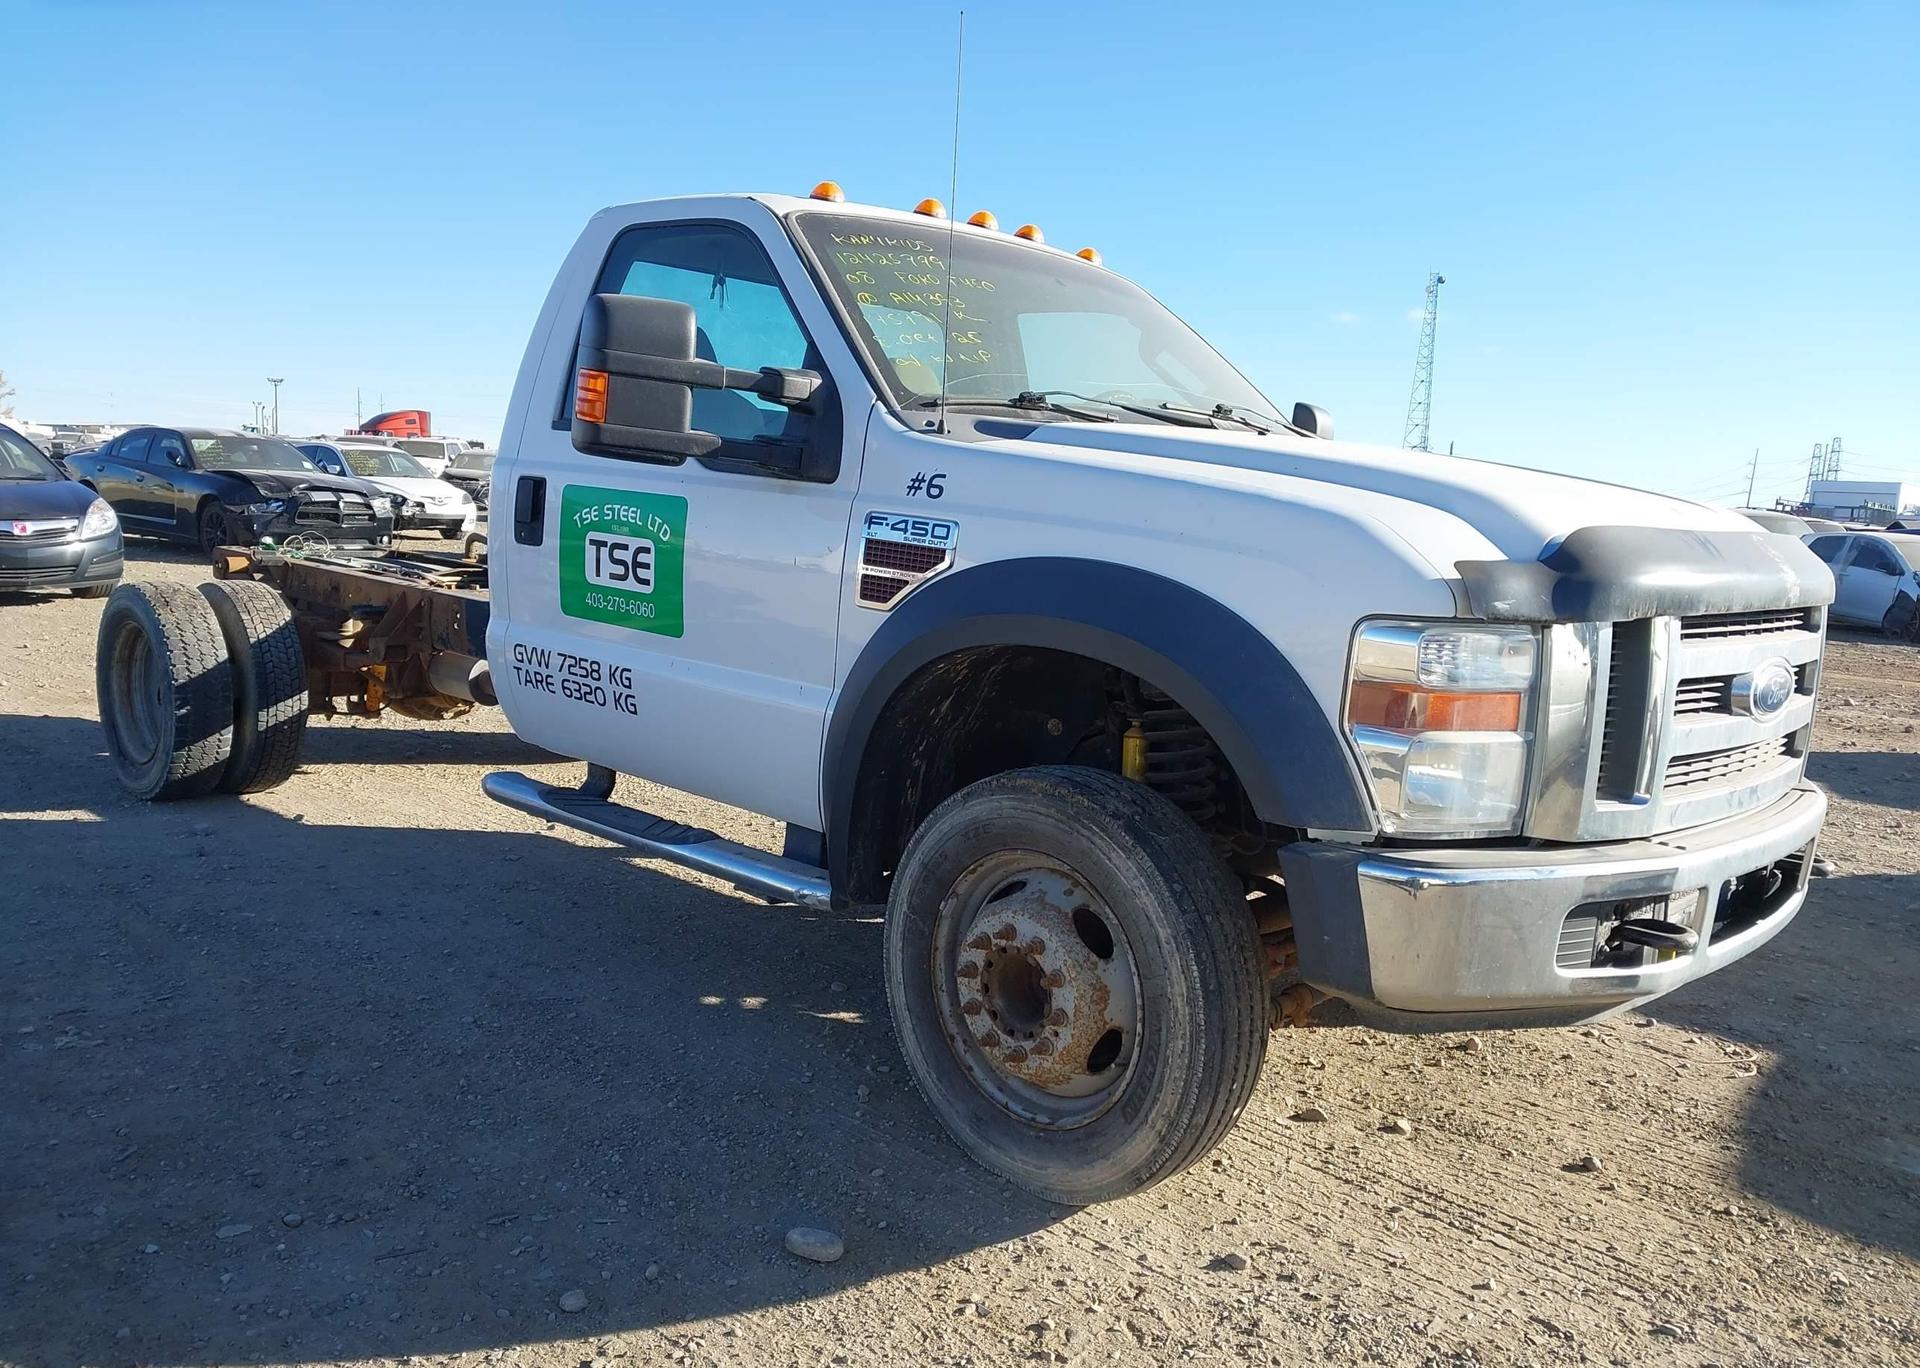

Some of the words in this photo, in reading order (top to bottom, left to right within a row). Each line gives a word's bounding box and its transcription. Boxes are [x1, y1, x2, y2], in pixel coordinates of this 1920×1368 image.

[906, 471, 947, 500] #6
[573, 505, 599, 529] TSE
[603, 504, 642, 525] STEEL
[647, 513, 671, 542] LTD
[867, 514, 951, 541] F-450
[903, 536, 927, 545] SUPER
[928, 539, 948, 547] DUTY
[588, 538, 652, 587] TSE
[585, 592, 656, 618] 403-279-6060
[513, 643, 552, 670] GVW
[556, 652, 602, 682] 7258
[608, 663, 633, 690] KG
[512, 665, 556, 694] TARE
[561, 678, 606, 707] 6320
[612, 690, 639, 716] KG
